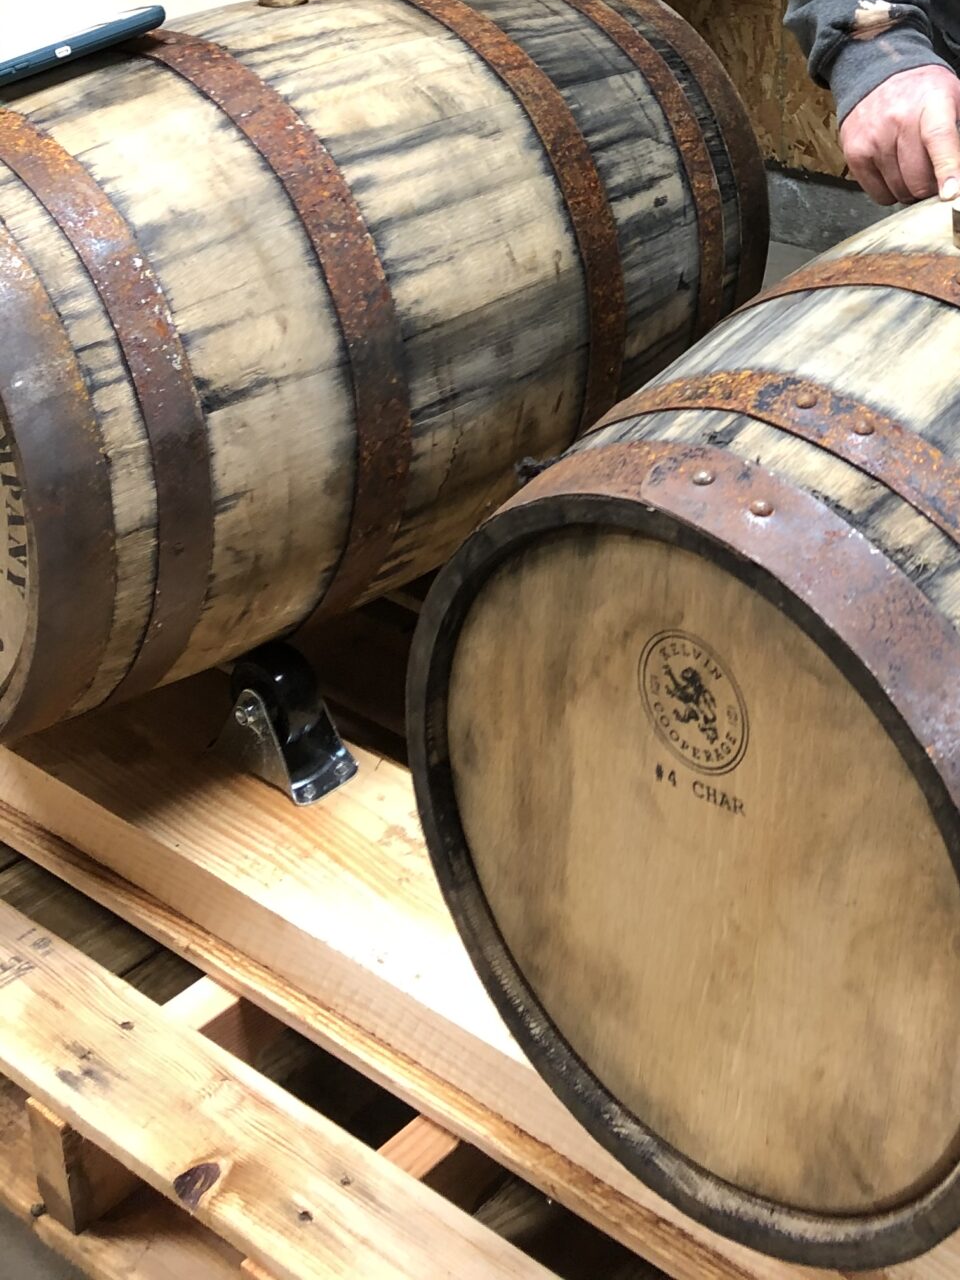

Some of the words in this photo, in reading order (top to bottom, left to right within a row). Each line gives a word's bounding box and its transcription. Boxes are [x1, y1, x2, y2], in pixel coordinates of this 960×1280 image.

[659, 642, 722, 681] KELVIN
[653, 701, 738, 764] COOPERAGE
[655, 762, 677, 788] #4
[692, 780, 746, 818] CHAR
